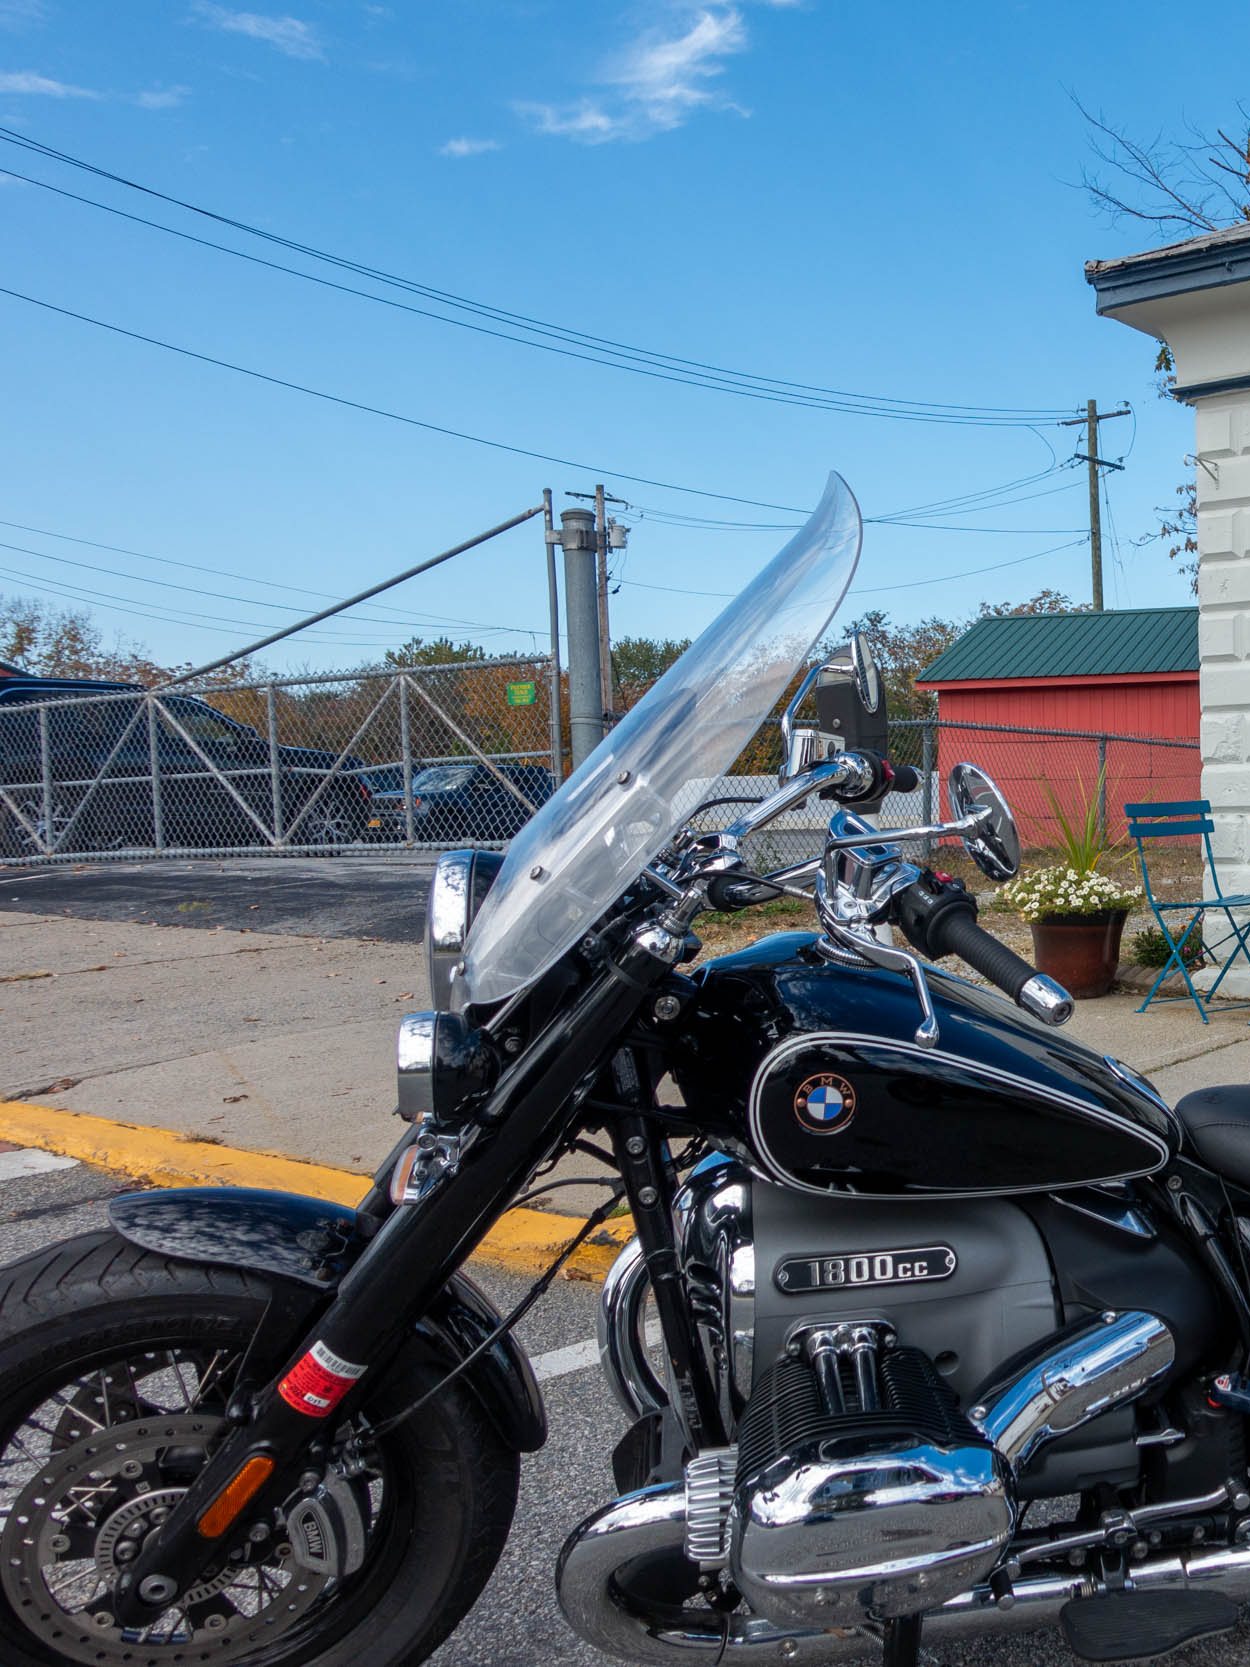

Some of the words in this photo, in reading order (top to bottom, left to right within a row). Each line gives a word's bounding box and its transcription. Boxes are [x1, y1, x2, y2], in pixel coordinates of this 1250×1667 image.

[802, 1076, 851, 1095] BMW
[807, 1255, 929, 1288] 1800cc
[303, 1521, 323, 1553] BMW
